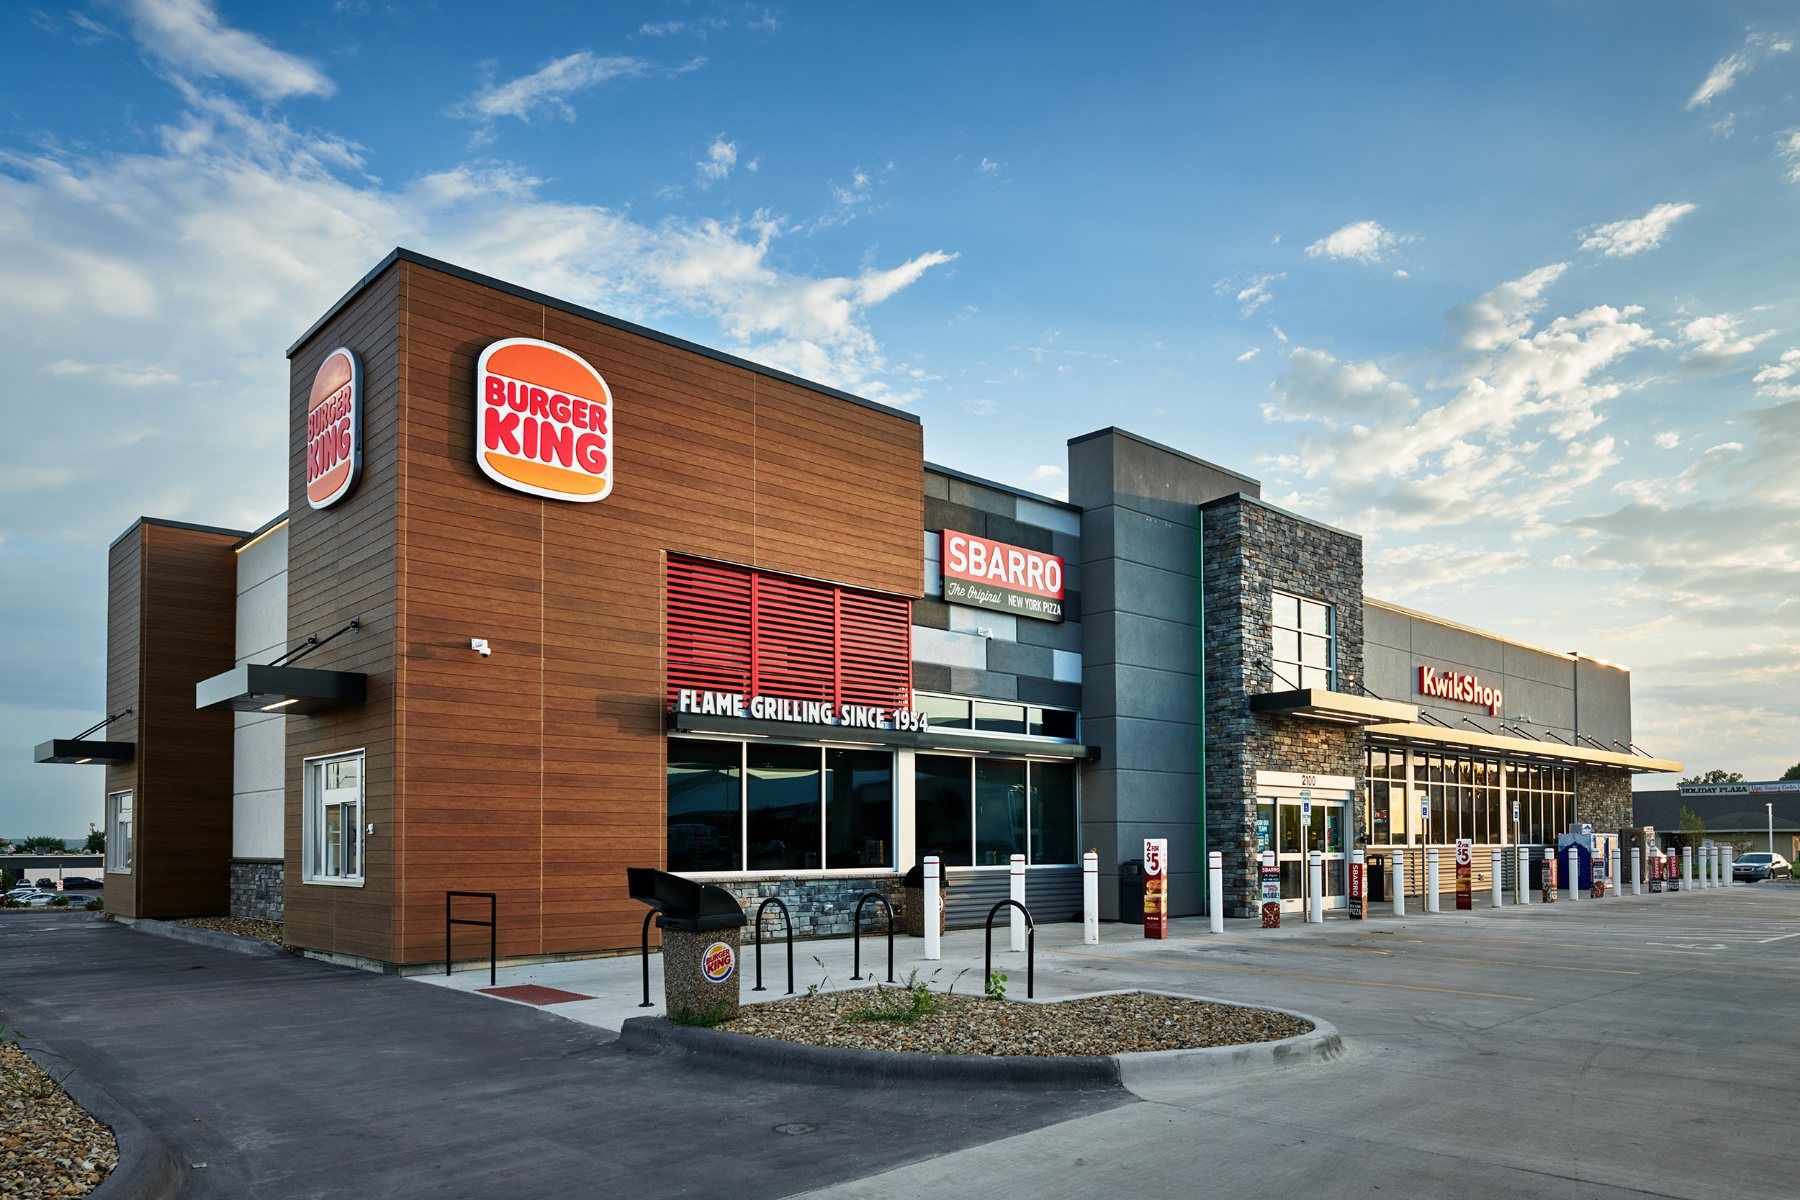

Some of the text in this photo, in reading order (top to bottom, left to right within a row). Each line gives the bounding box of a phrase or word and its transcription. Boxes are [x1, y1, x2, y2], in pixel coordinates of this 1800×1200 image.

[307, 385, 352, 442] BURGER
[485, 375, 608, 435] BURGER
[307, 416, 351, 483] KING
[484, 407, 608, 475] KING
[948, 536, 1062, 593] SBARRO
[948, 582, 1062, 616] The Original NEW YORK PIZZA
[680, 688, 929, 732] FLAME GRILLING SINCE 1954
[1421, 665, 1503, 716] KwikShop
[1301, 774, 1316, 787] 2100
[1146, 841, 1151, 852] 2
[1146, 852, 1160, 871] $5
[1457, 848, 1470, 862] $5
[706, 948, 730, 966] BURGER
[707, 955, 731, 974] KING
